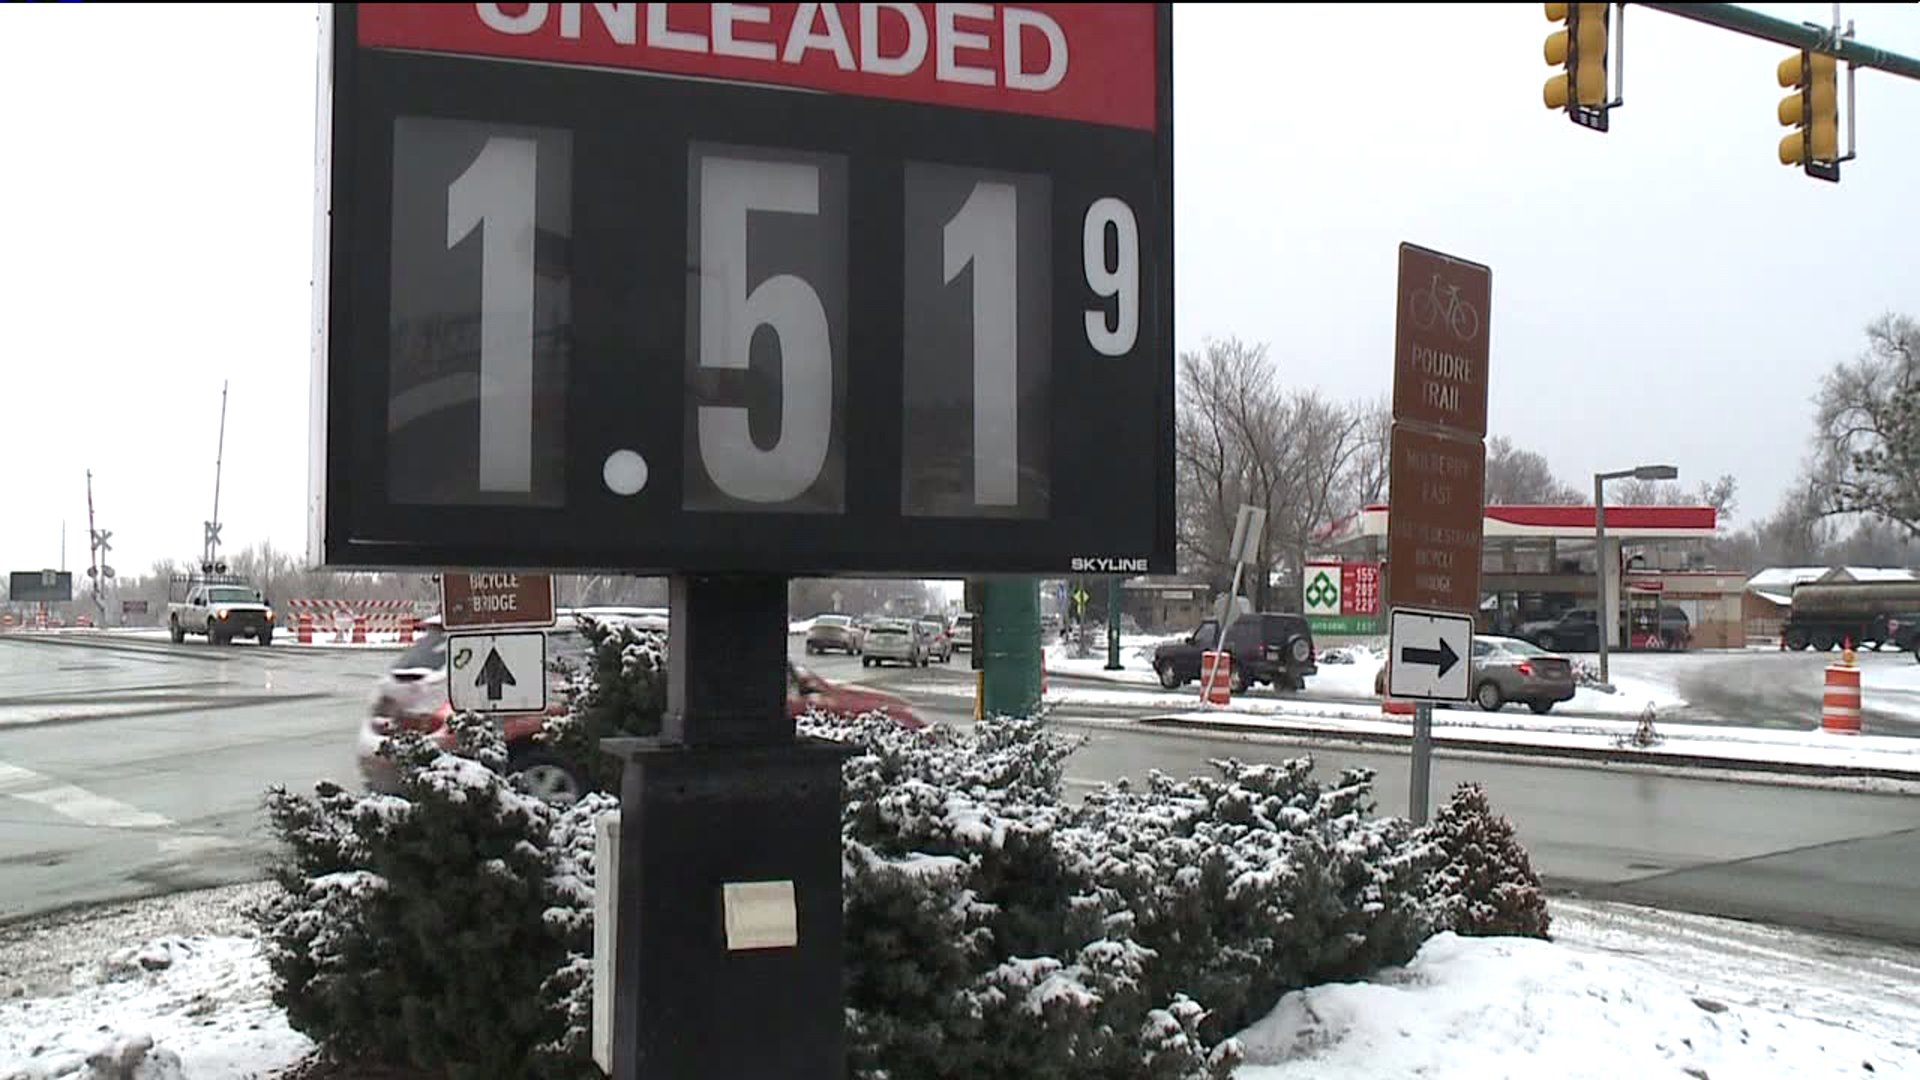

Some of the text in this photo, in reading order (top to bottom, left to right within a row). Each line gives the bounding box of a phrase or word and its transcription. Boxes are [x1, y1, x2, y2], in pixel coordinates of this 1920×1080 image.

[1082, 197, 1141, 356] 9
[1411, 341, 1473, 384] POUDRE
[1422, 382, 1462, 415] TRAIL
[1071, 557, 1148, 572] SKYLINE
[470, 573, 519, 590] BICYCLE
[473, 593, 517, 612] BRIDGE
